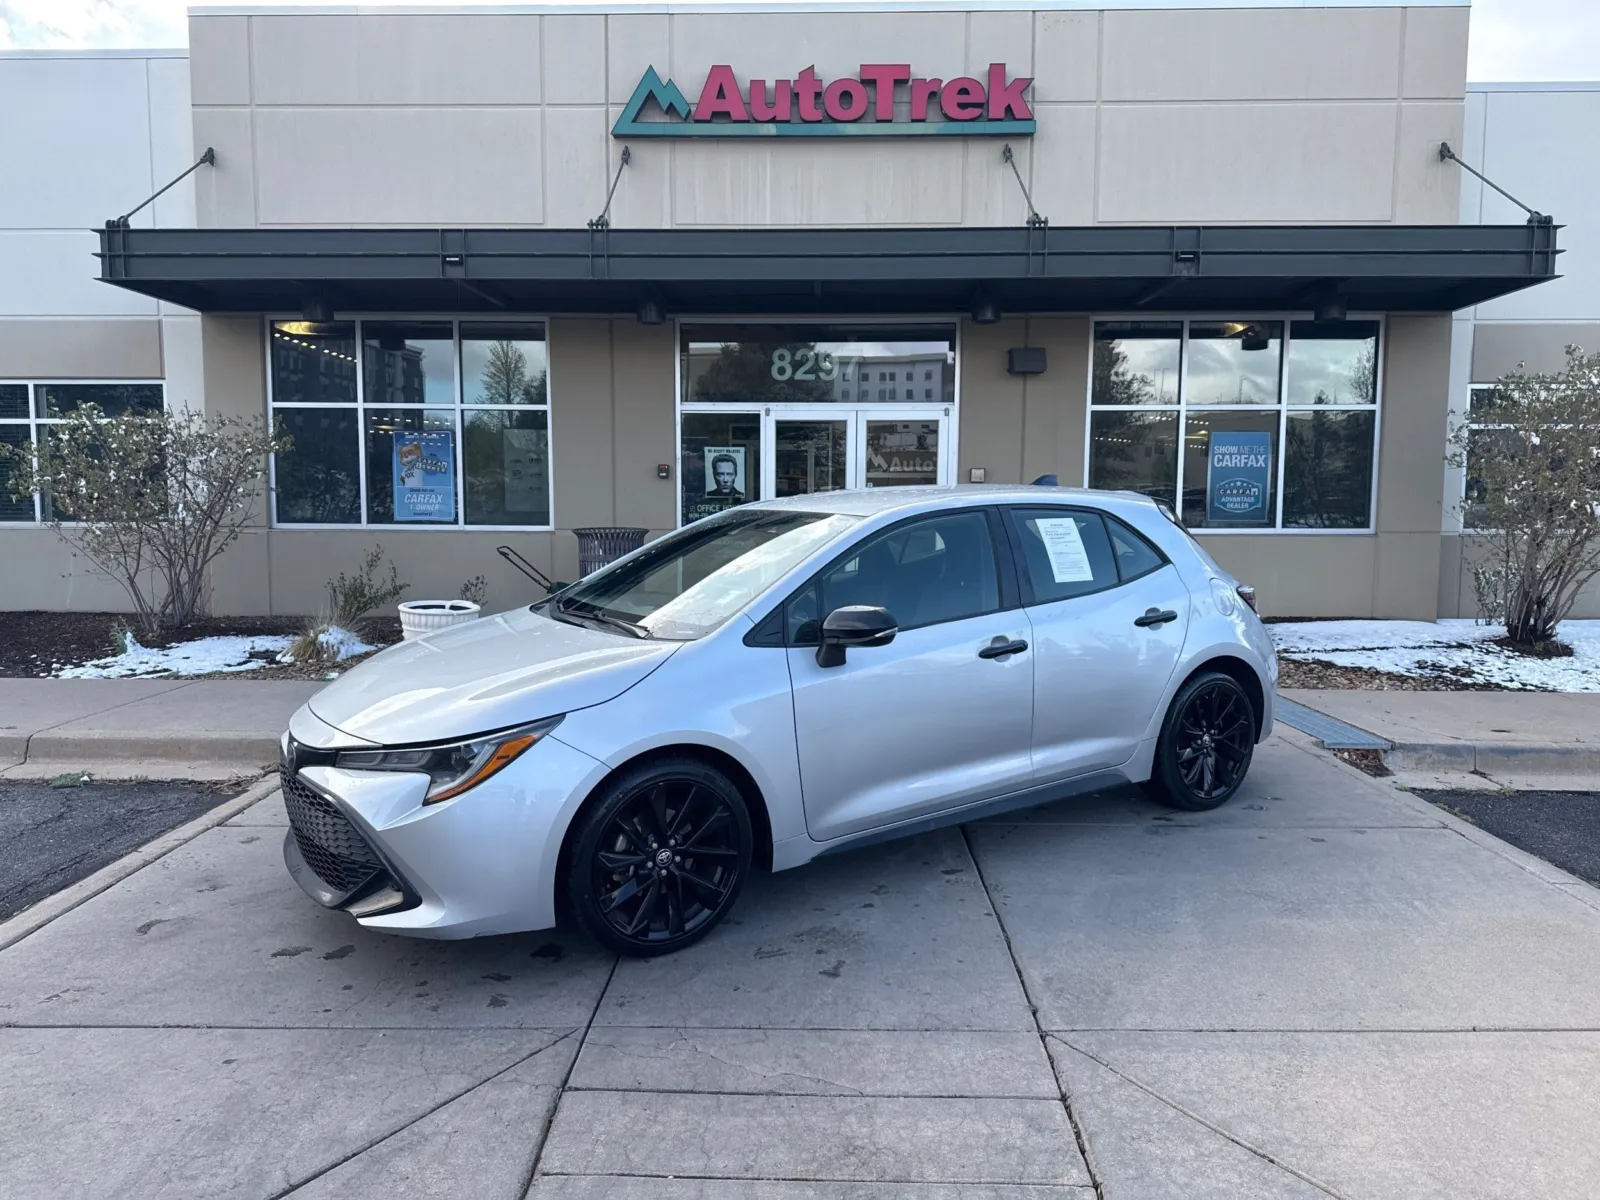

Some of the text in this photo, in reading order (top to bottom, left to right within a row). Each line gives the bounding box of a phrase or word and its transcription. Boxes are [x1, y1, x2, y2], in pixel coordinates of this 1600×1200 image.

[693, 63, 1035, 123] AutoTrek
[770, 348, 863, 381] 8297
[1214, 445, 1267, 454] SHOW ME THE
[889, 456, 937, 472] Auto
[1213, 454, 1267, 468] CARFAX
[404, 493, 443, 504] CARFAX
[697, 504, 720, 512] OFFICE
